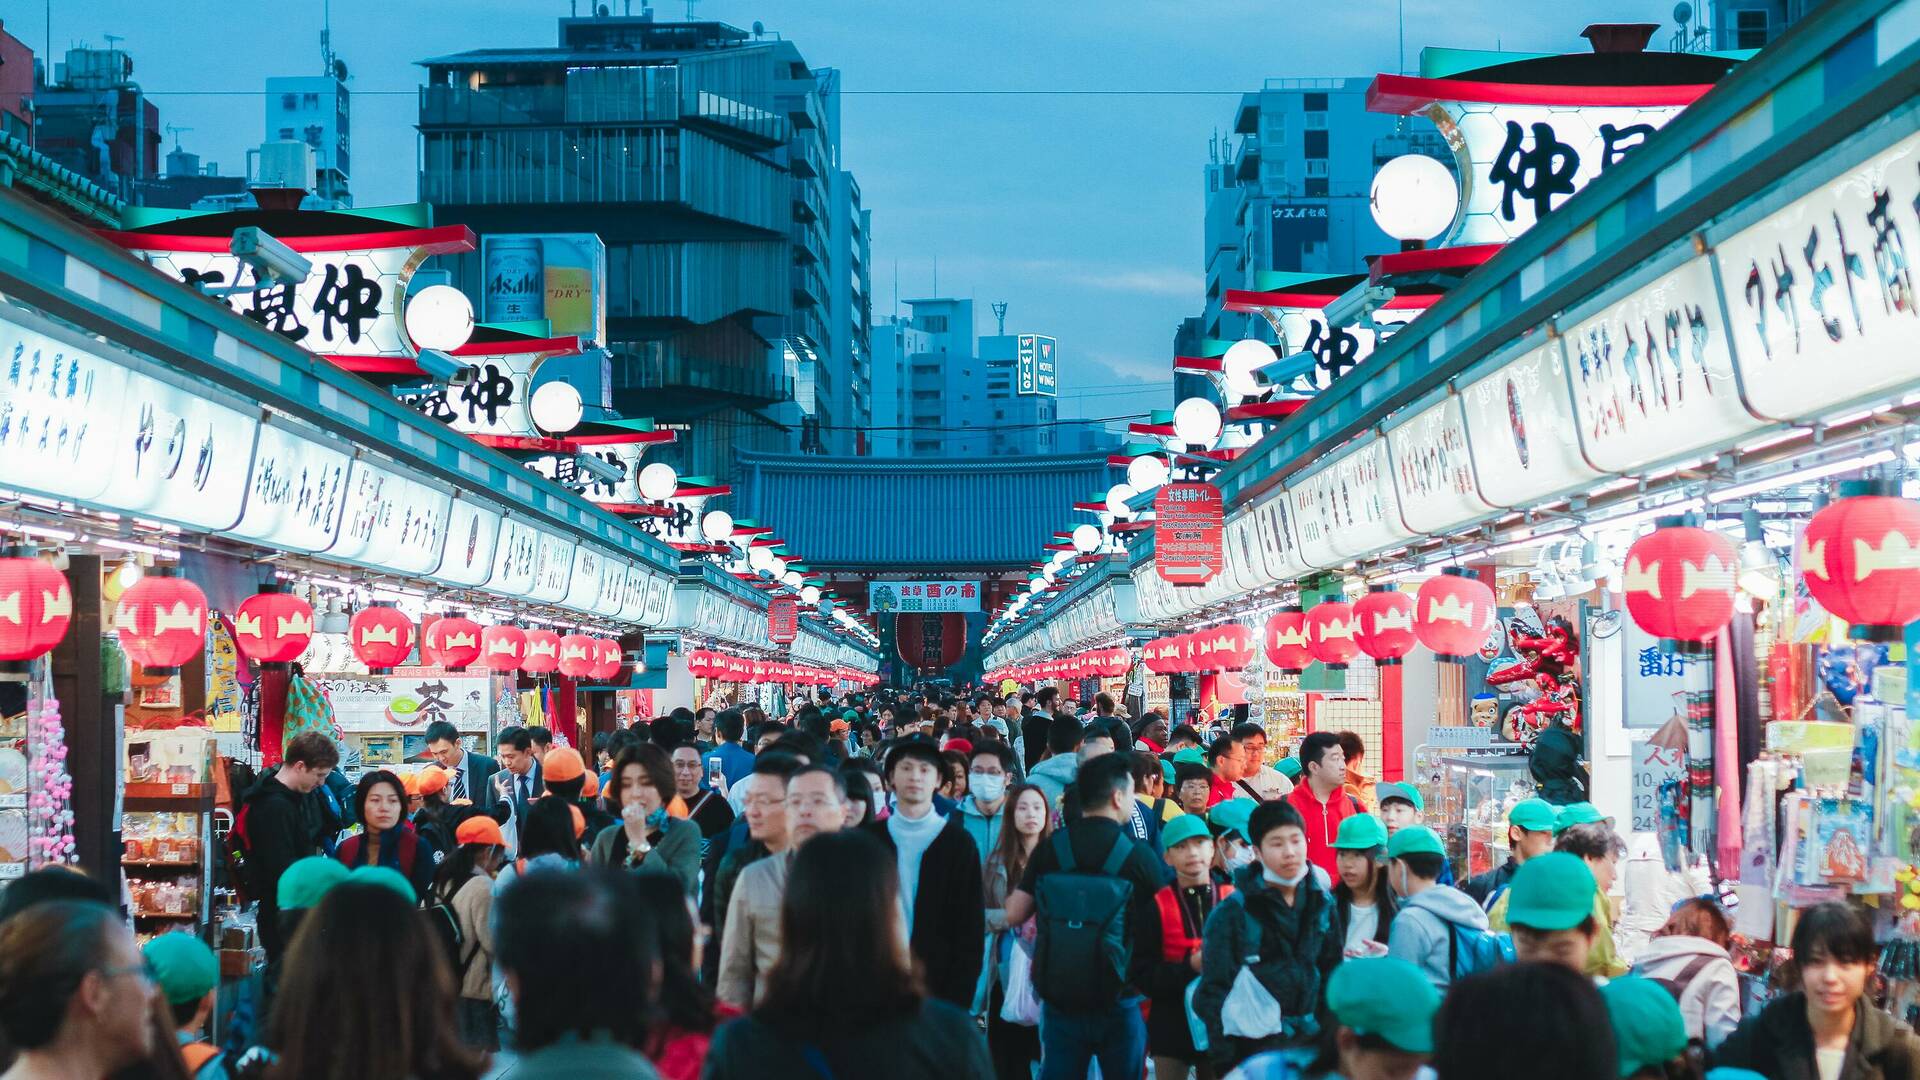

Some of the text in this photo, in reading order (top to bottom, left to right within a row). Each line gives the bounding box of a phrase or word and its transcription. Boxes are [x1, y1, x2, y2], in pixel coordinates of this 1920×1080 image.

[489, 272, 539, 295] Asahi
[180, 263, 383, 344] 仲見
[506, 304, 521, 314] 生
[1021, 356, 1032, 389] WING
[1038, 374, 1055, 387] WING
[1168, 488, 1210, 502] 女性専用トイレ
[927, 583, 976, 598] 酉の市
[415, 679, 454, 721] 茶
[1634, 794, 1652, 809] 12
[1633, 816, 1651, 831] 24
